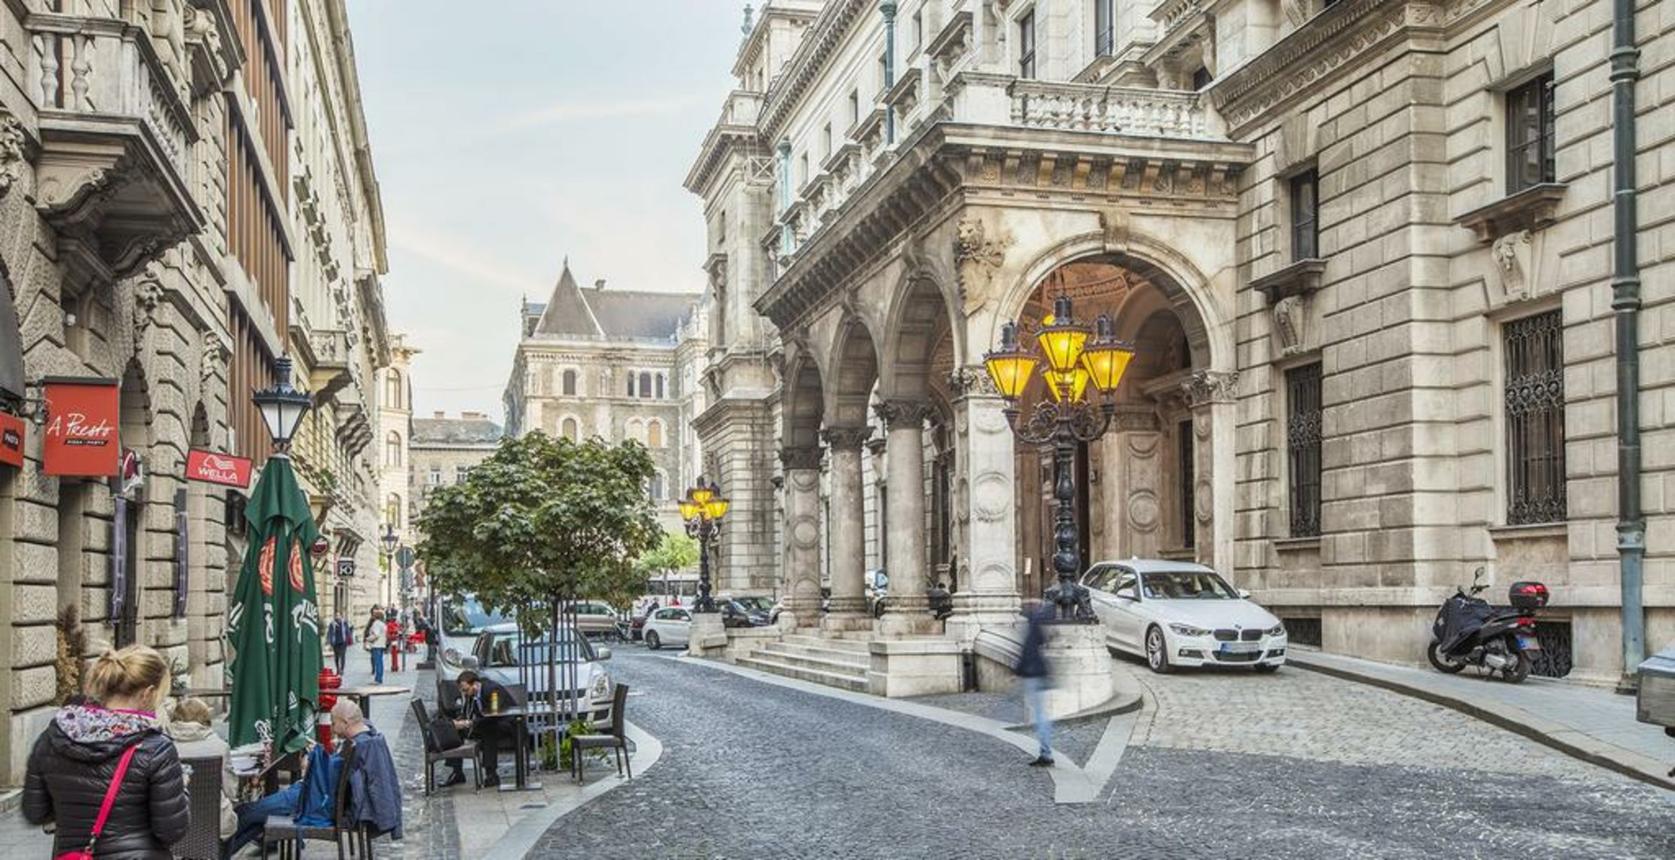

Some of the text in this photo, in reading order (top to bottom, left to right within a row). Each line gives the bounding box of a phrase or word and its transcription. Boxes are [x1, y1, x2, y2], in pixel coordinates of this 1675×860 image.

[47, 412, 115, 436] A Presto
[198, 466, 238, 484] WELLA
